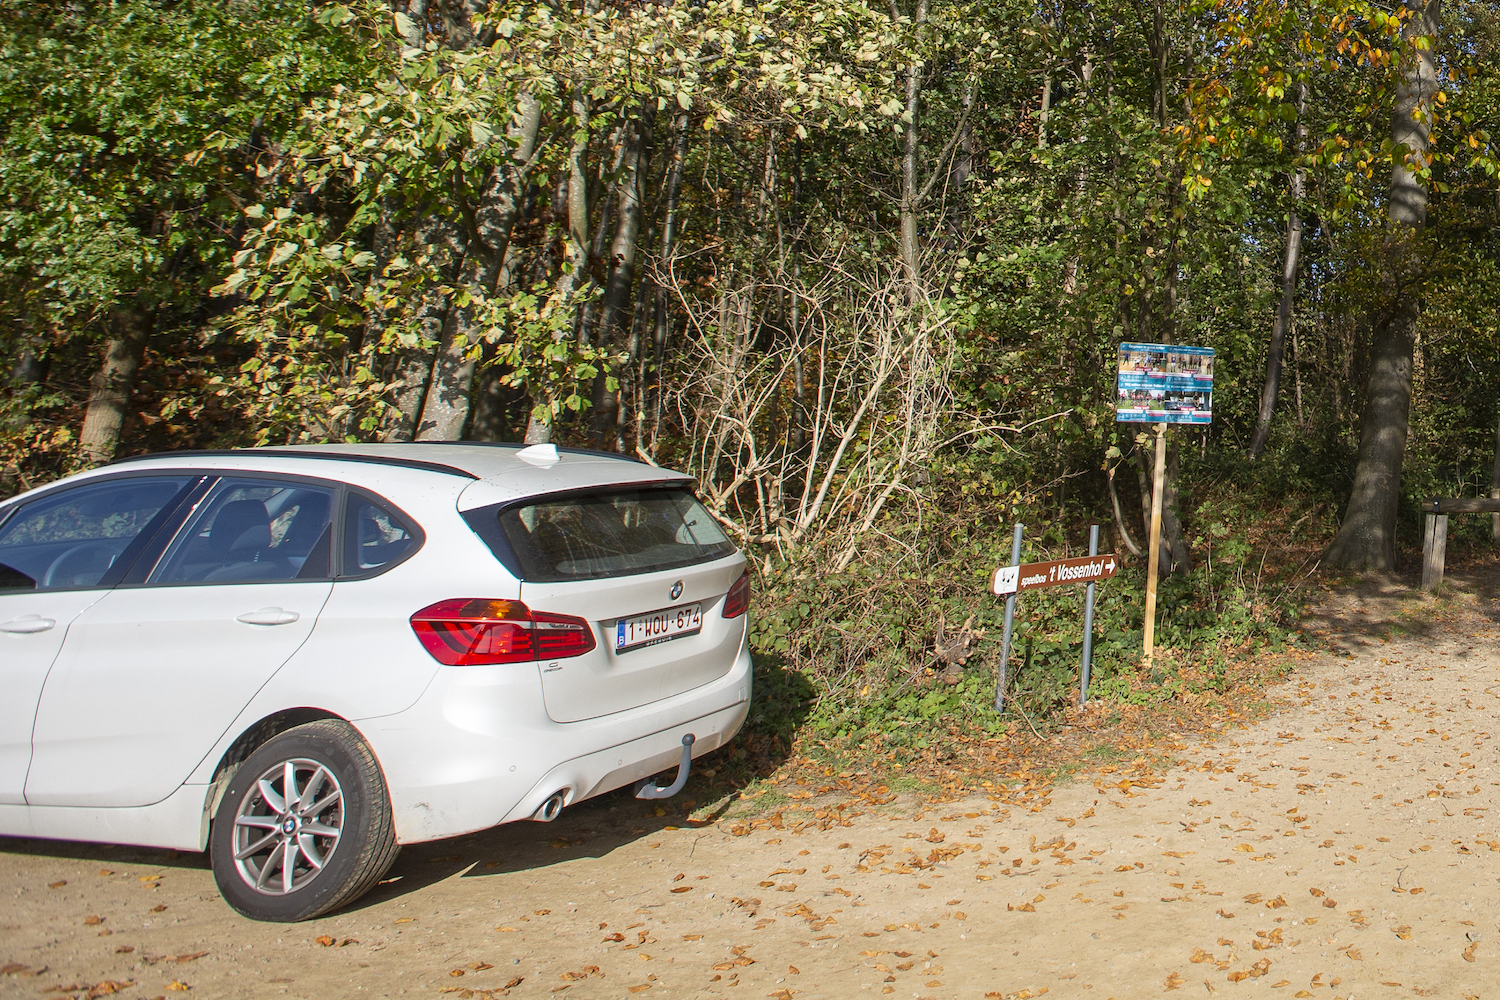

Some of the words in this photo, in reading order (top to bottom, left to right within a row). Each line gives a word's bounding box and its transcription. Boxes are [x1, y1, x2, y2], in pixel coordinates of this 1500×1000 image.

[1020, 573, 1047, 588] speelbos
[1057, 559, 1105, 582] Vossenhol
[618, 635, 625, 645] B
